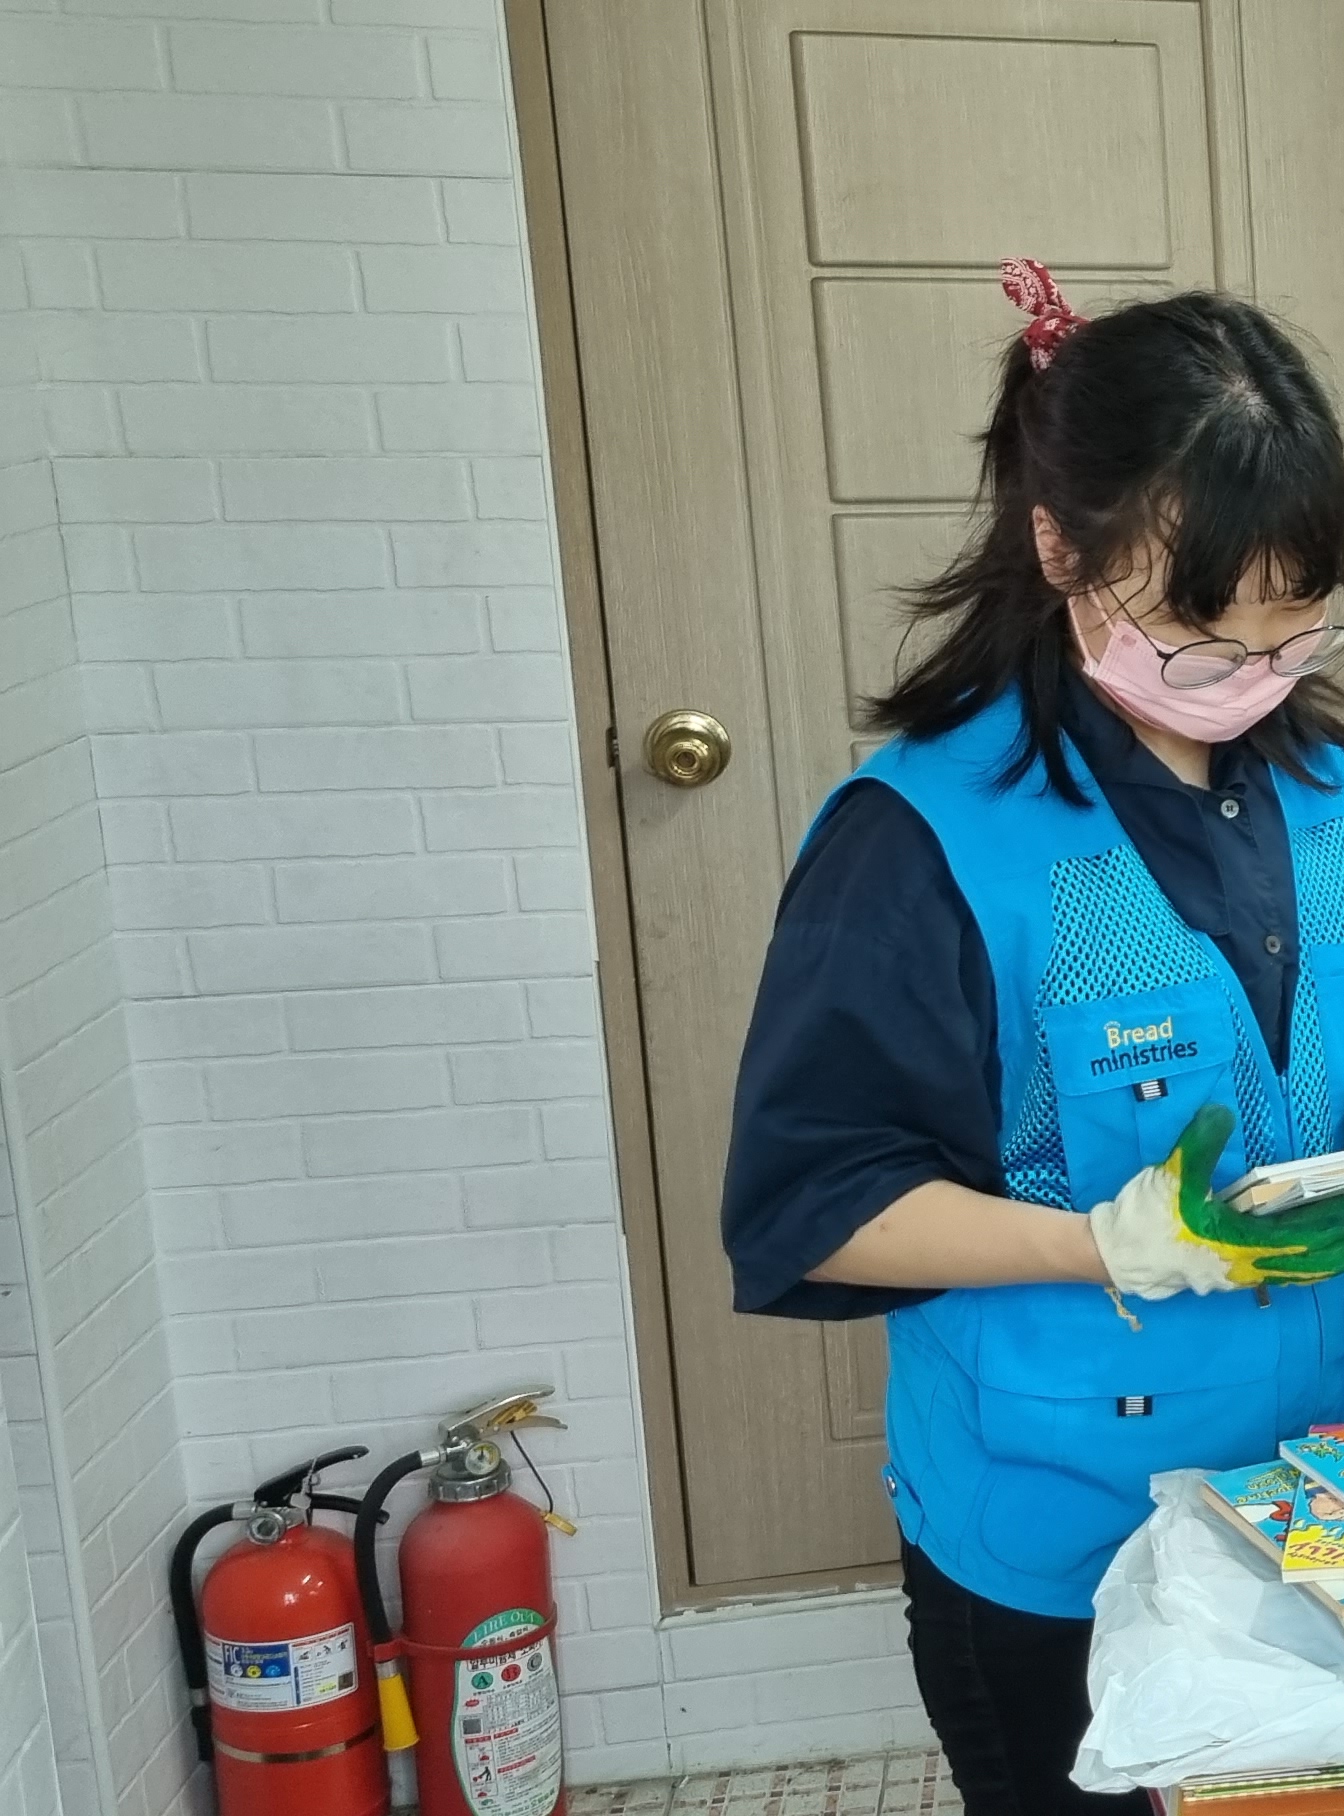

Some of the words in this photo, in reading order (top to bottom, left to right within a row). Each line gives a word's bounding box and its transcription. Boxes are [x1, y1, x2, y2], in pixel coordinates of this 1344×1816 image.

[1106, 1016, 1173, 1049] Bread
[1090, 1039, 1198, 1077] ministries
[473, 1616, 508, 1642] FIRE
[224, 1644, 241, 1664] FIC
